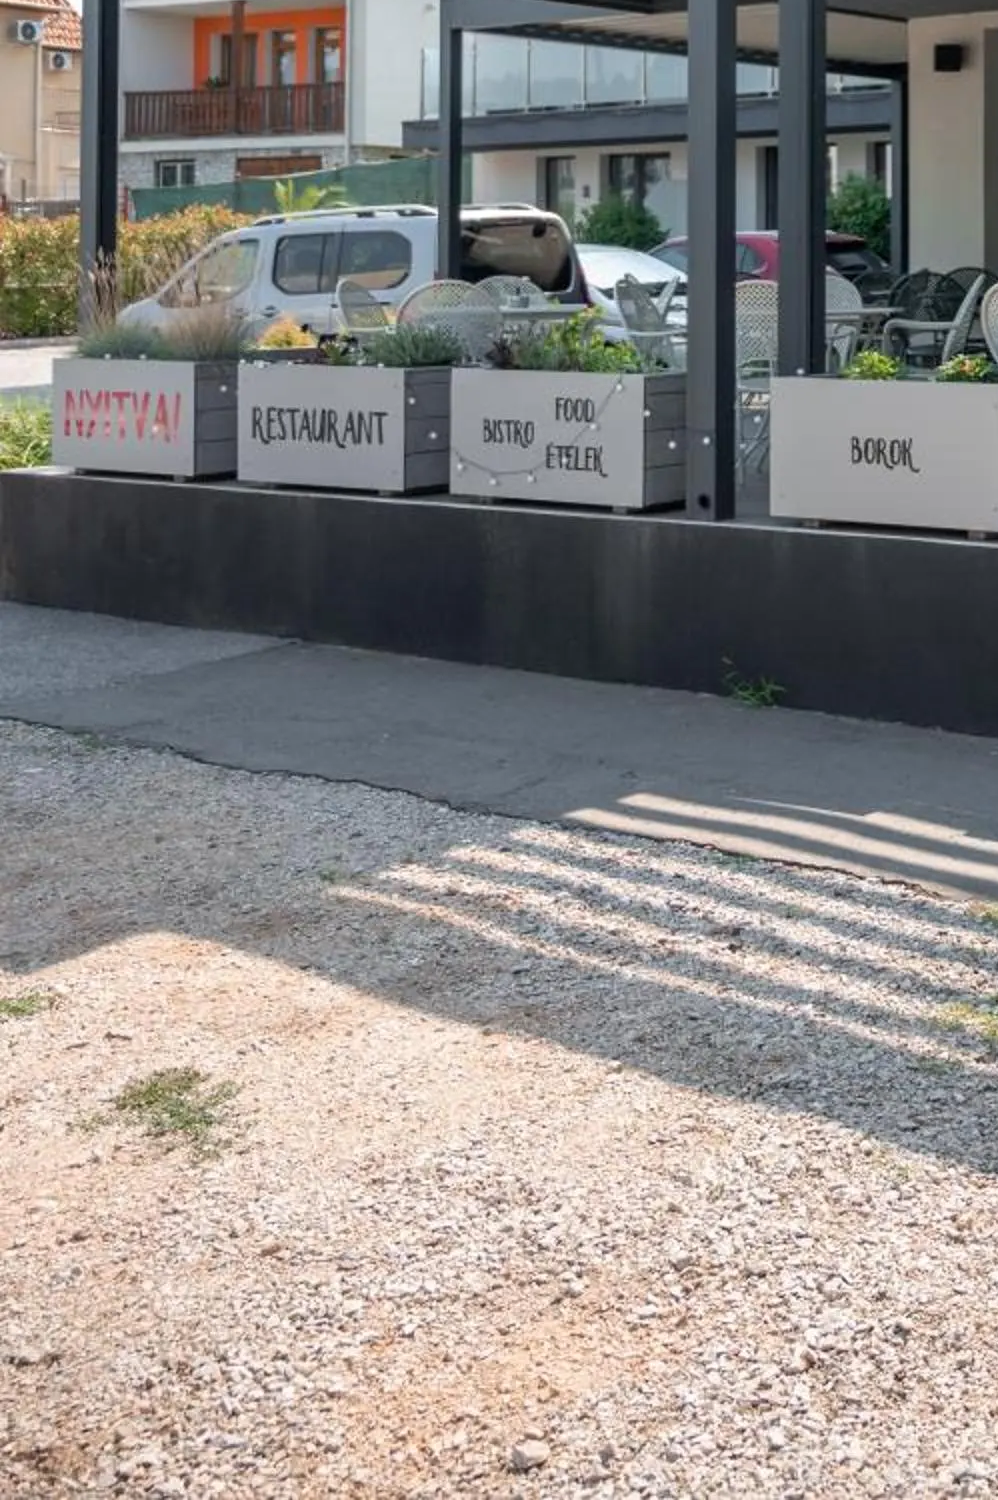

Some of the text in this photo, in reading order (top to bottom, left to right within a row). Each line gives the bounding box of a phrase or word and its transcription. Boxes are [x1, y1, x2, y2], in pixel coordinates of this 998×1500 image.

[554, 397, 595, 423] FOOD
[251, 406, 389, 449] RESTAURANT
[483, 418, 535, 449] BISTRO
[850, 436, 920, 473] BOROK
